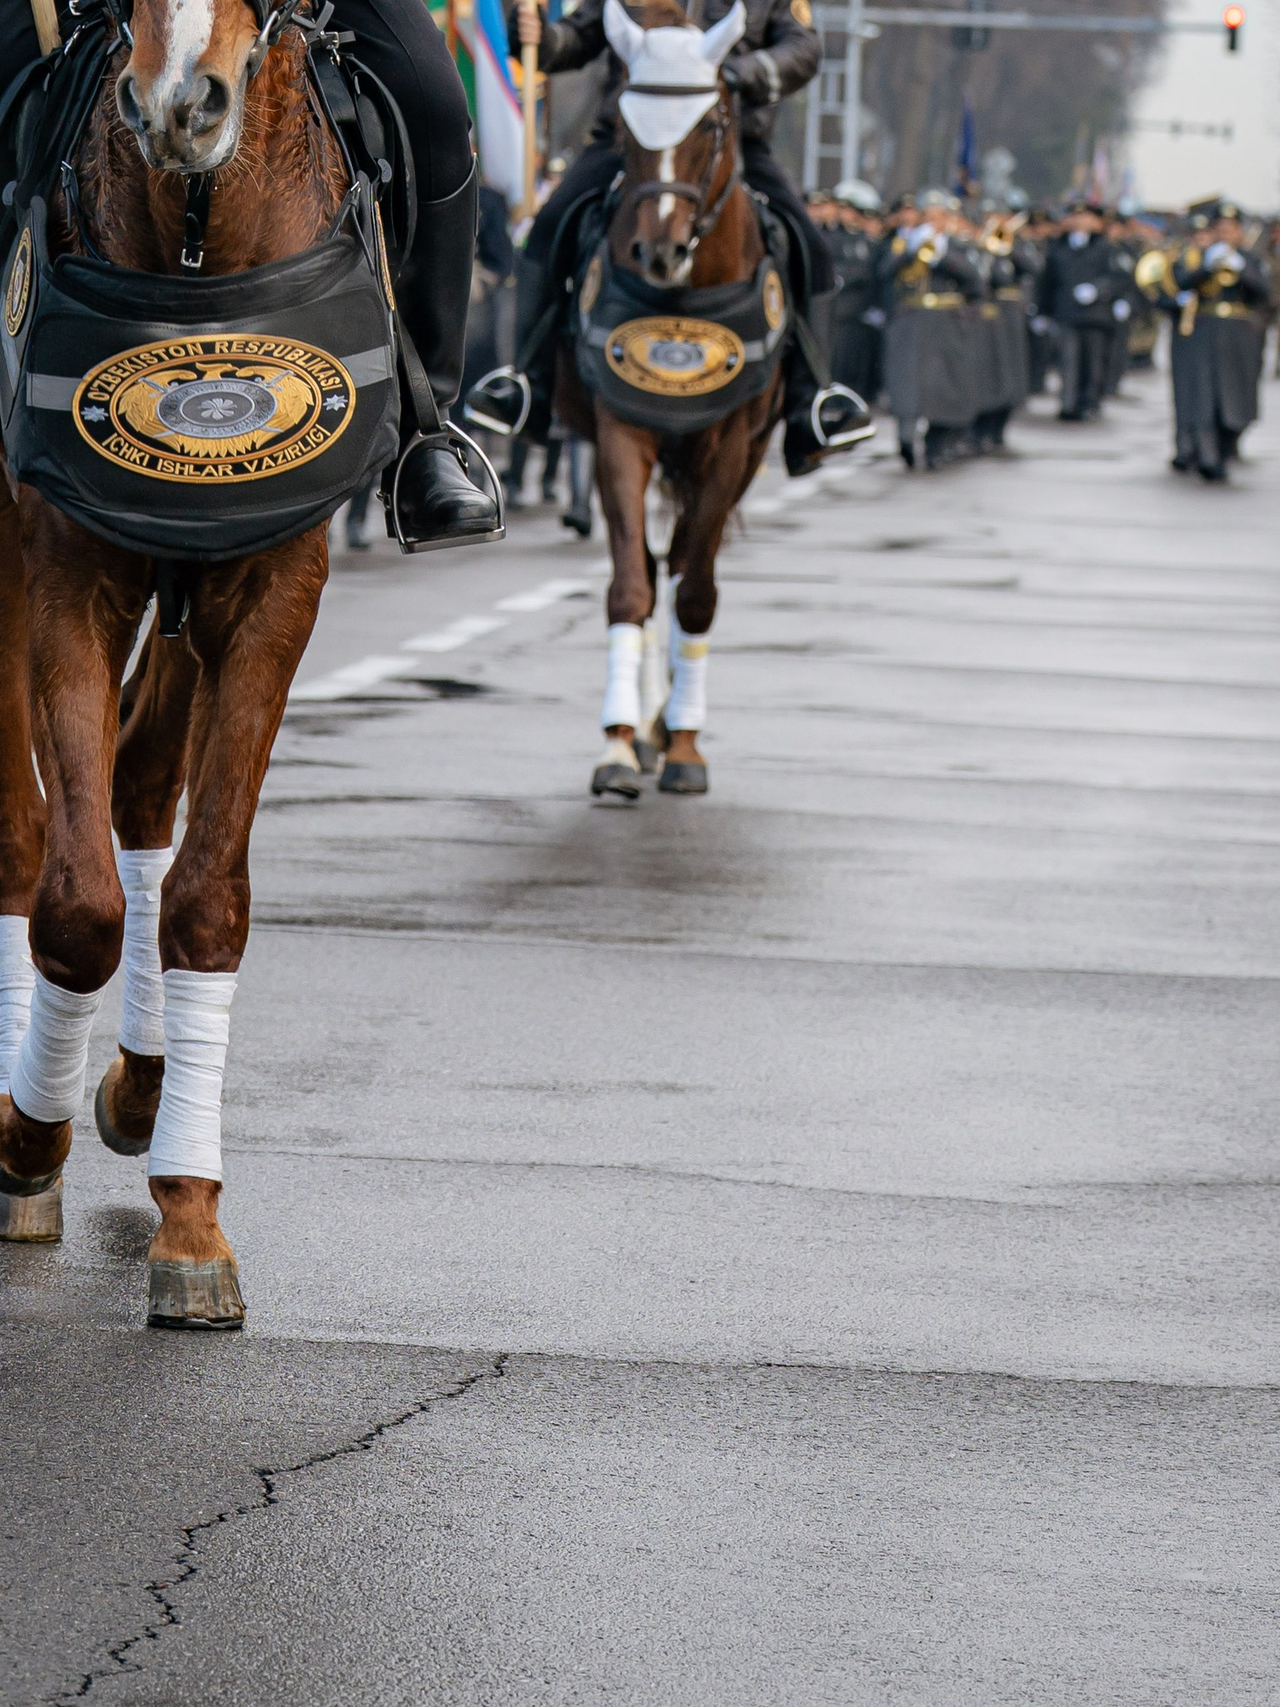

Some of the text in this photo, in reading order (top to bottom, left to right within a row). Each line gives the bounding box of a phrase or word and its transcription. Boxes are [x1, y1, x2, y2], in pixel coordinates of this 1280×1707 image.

[87, 340, 344, 402] O'ZBEKISTON RESPUBLIKASI
[101, 423, 331, 477] ICHKI ISHLAR VAZIRLIGI
